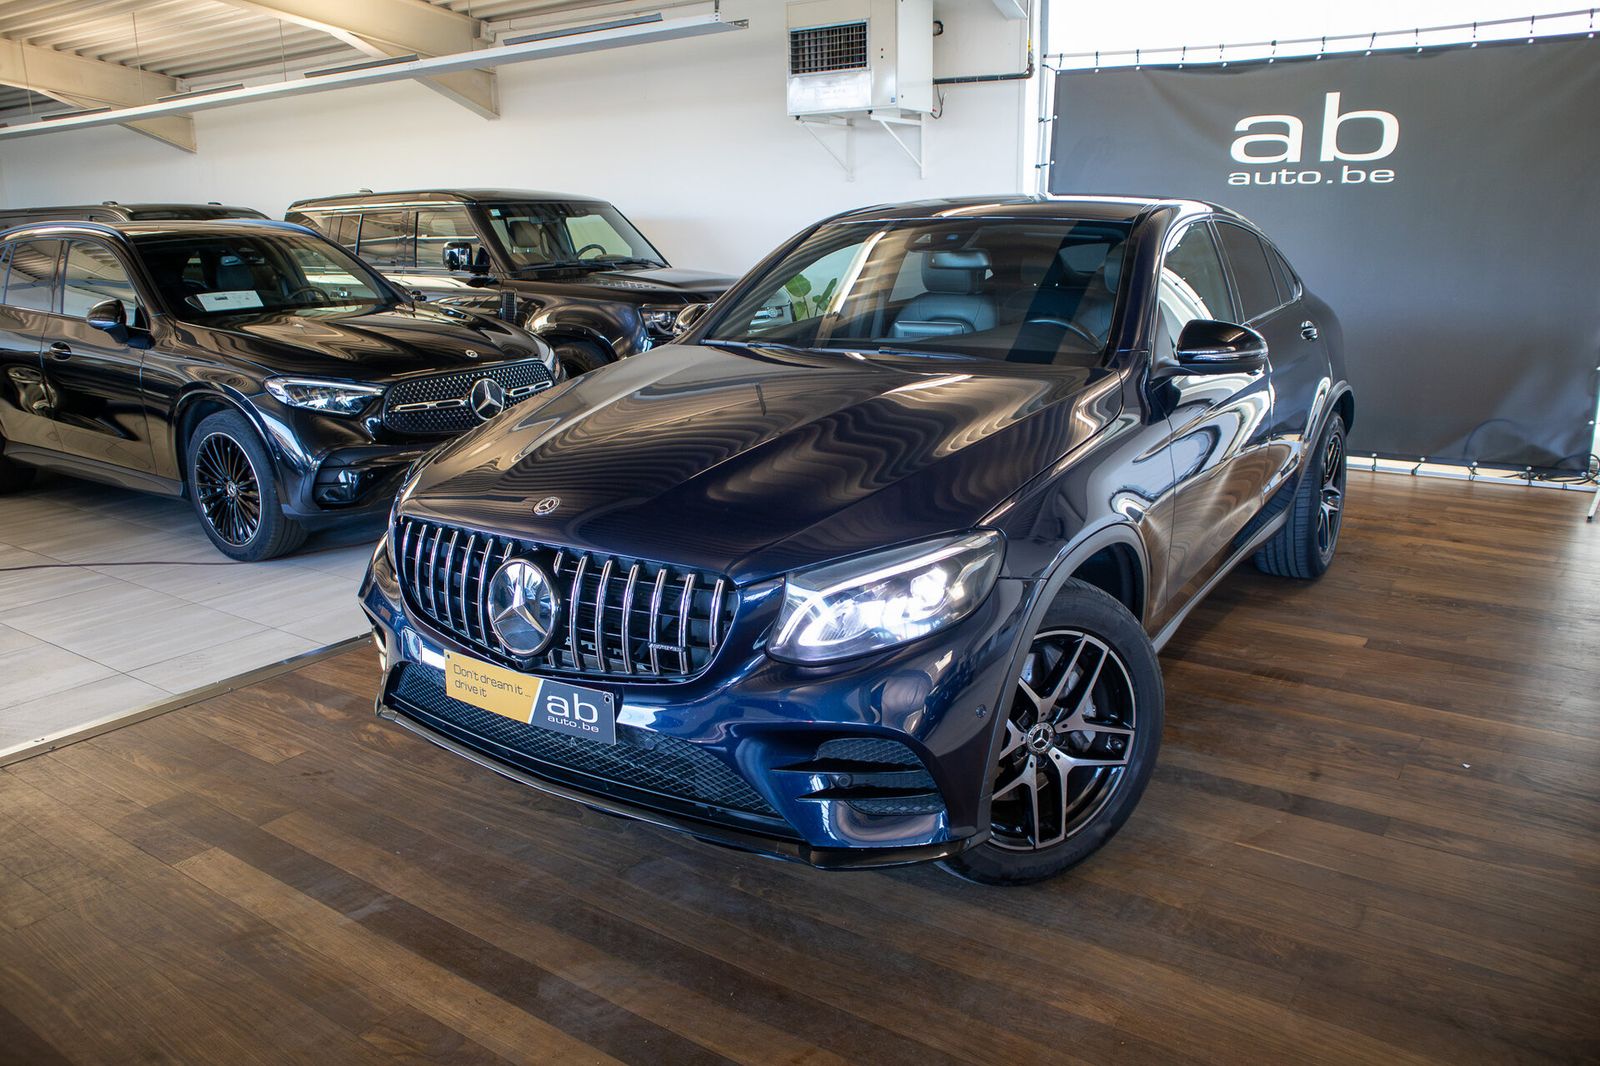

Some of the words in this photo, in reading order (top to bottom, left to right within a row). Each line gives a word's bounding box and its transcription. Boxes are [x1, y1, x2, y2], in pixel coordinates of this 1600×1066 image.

[1230, 92, 1400, 164] ab
[1227, 165, 1395, 185] auto.be
[453, 663, 479, 681] Don't
[480, 674, 514, 693] dream
[454, 679, 478, 695] drive
[479, 687, 487, 698] it
[546, 693, 599, 723] ab
[547, 715, 599, 733] auto.be
